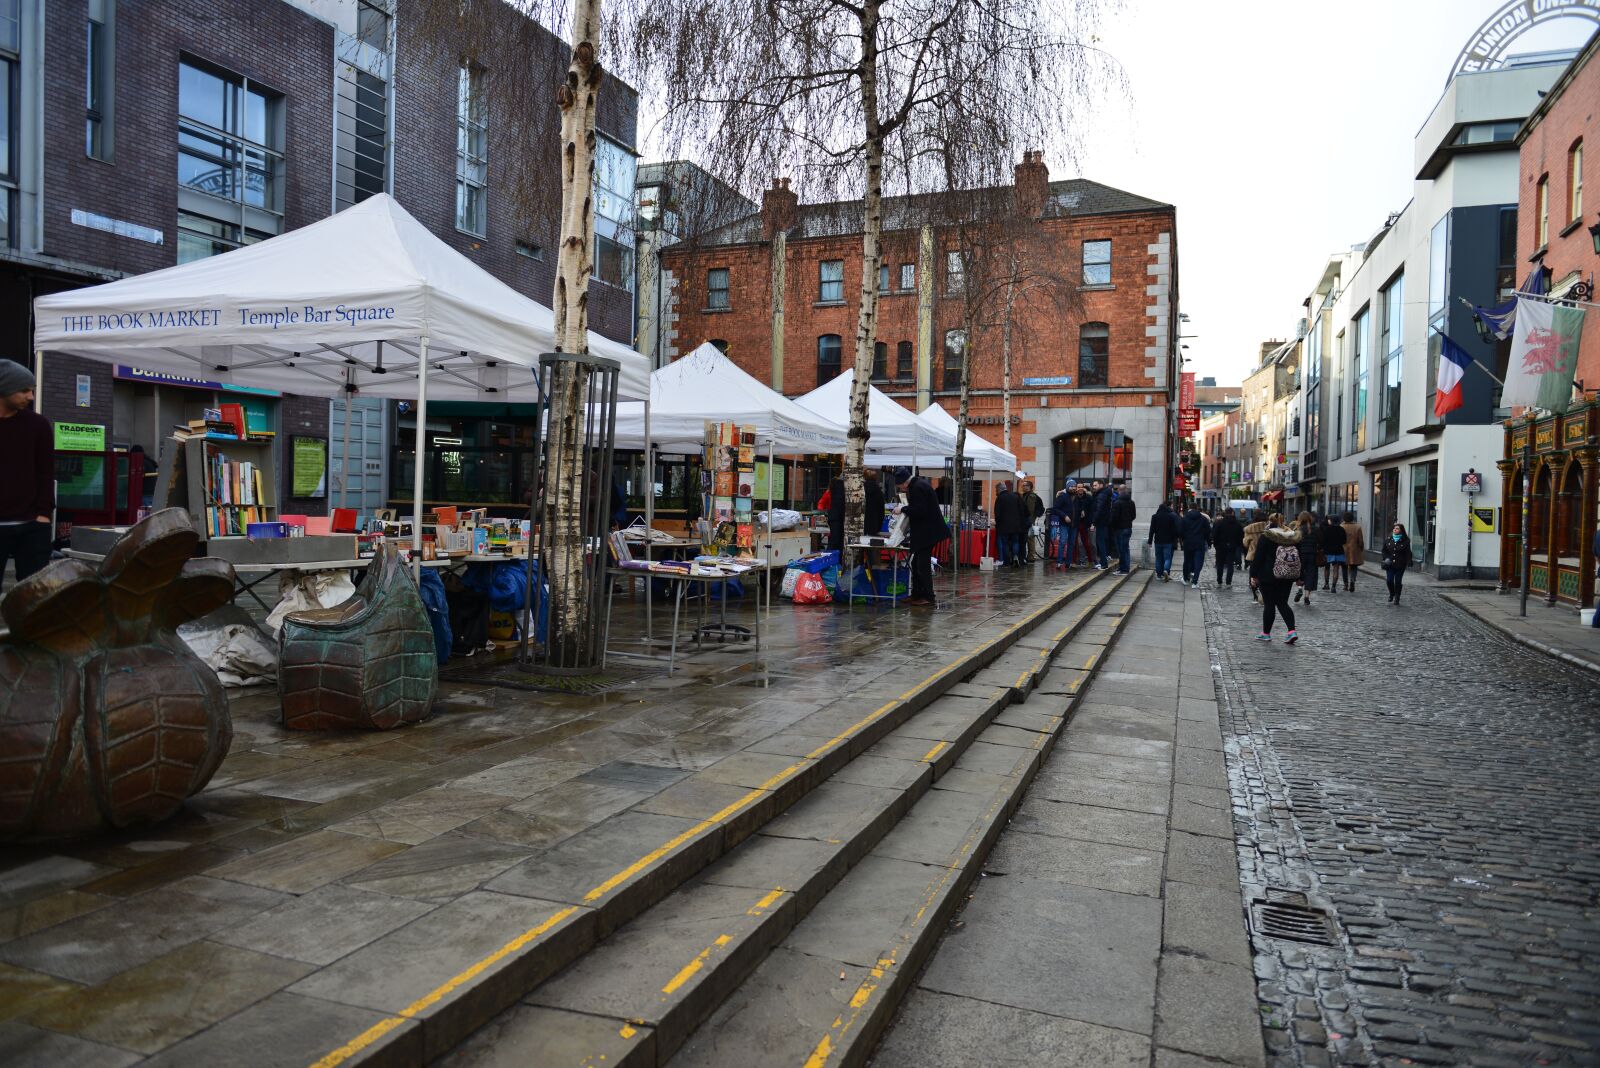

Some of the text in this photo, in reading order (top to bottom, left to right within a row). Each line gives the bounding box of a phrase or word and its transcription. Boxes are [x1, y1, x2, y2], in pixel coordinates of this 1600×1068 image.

[1474, 4, 1529, 57] UNION
[62, 304, 395, 332] THE BOOK MARKET Temple Bar Square
